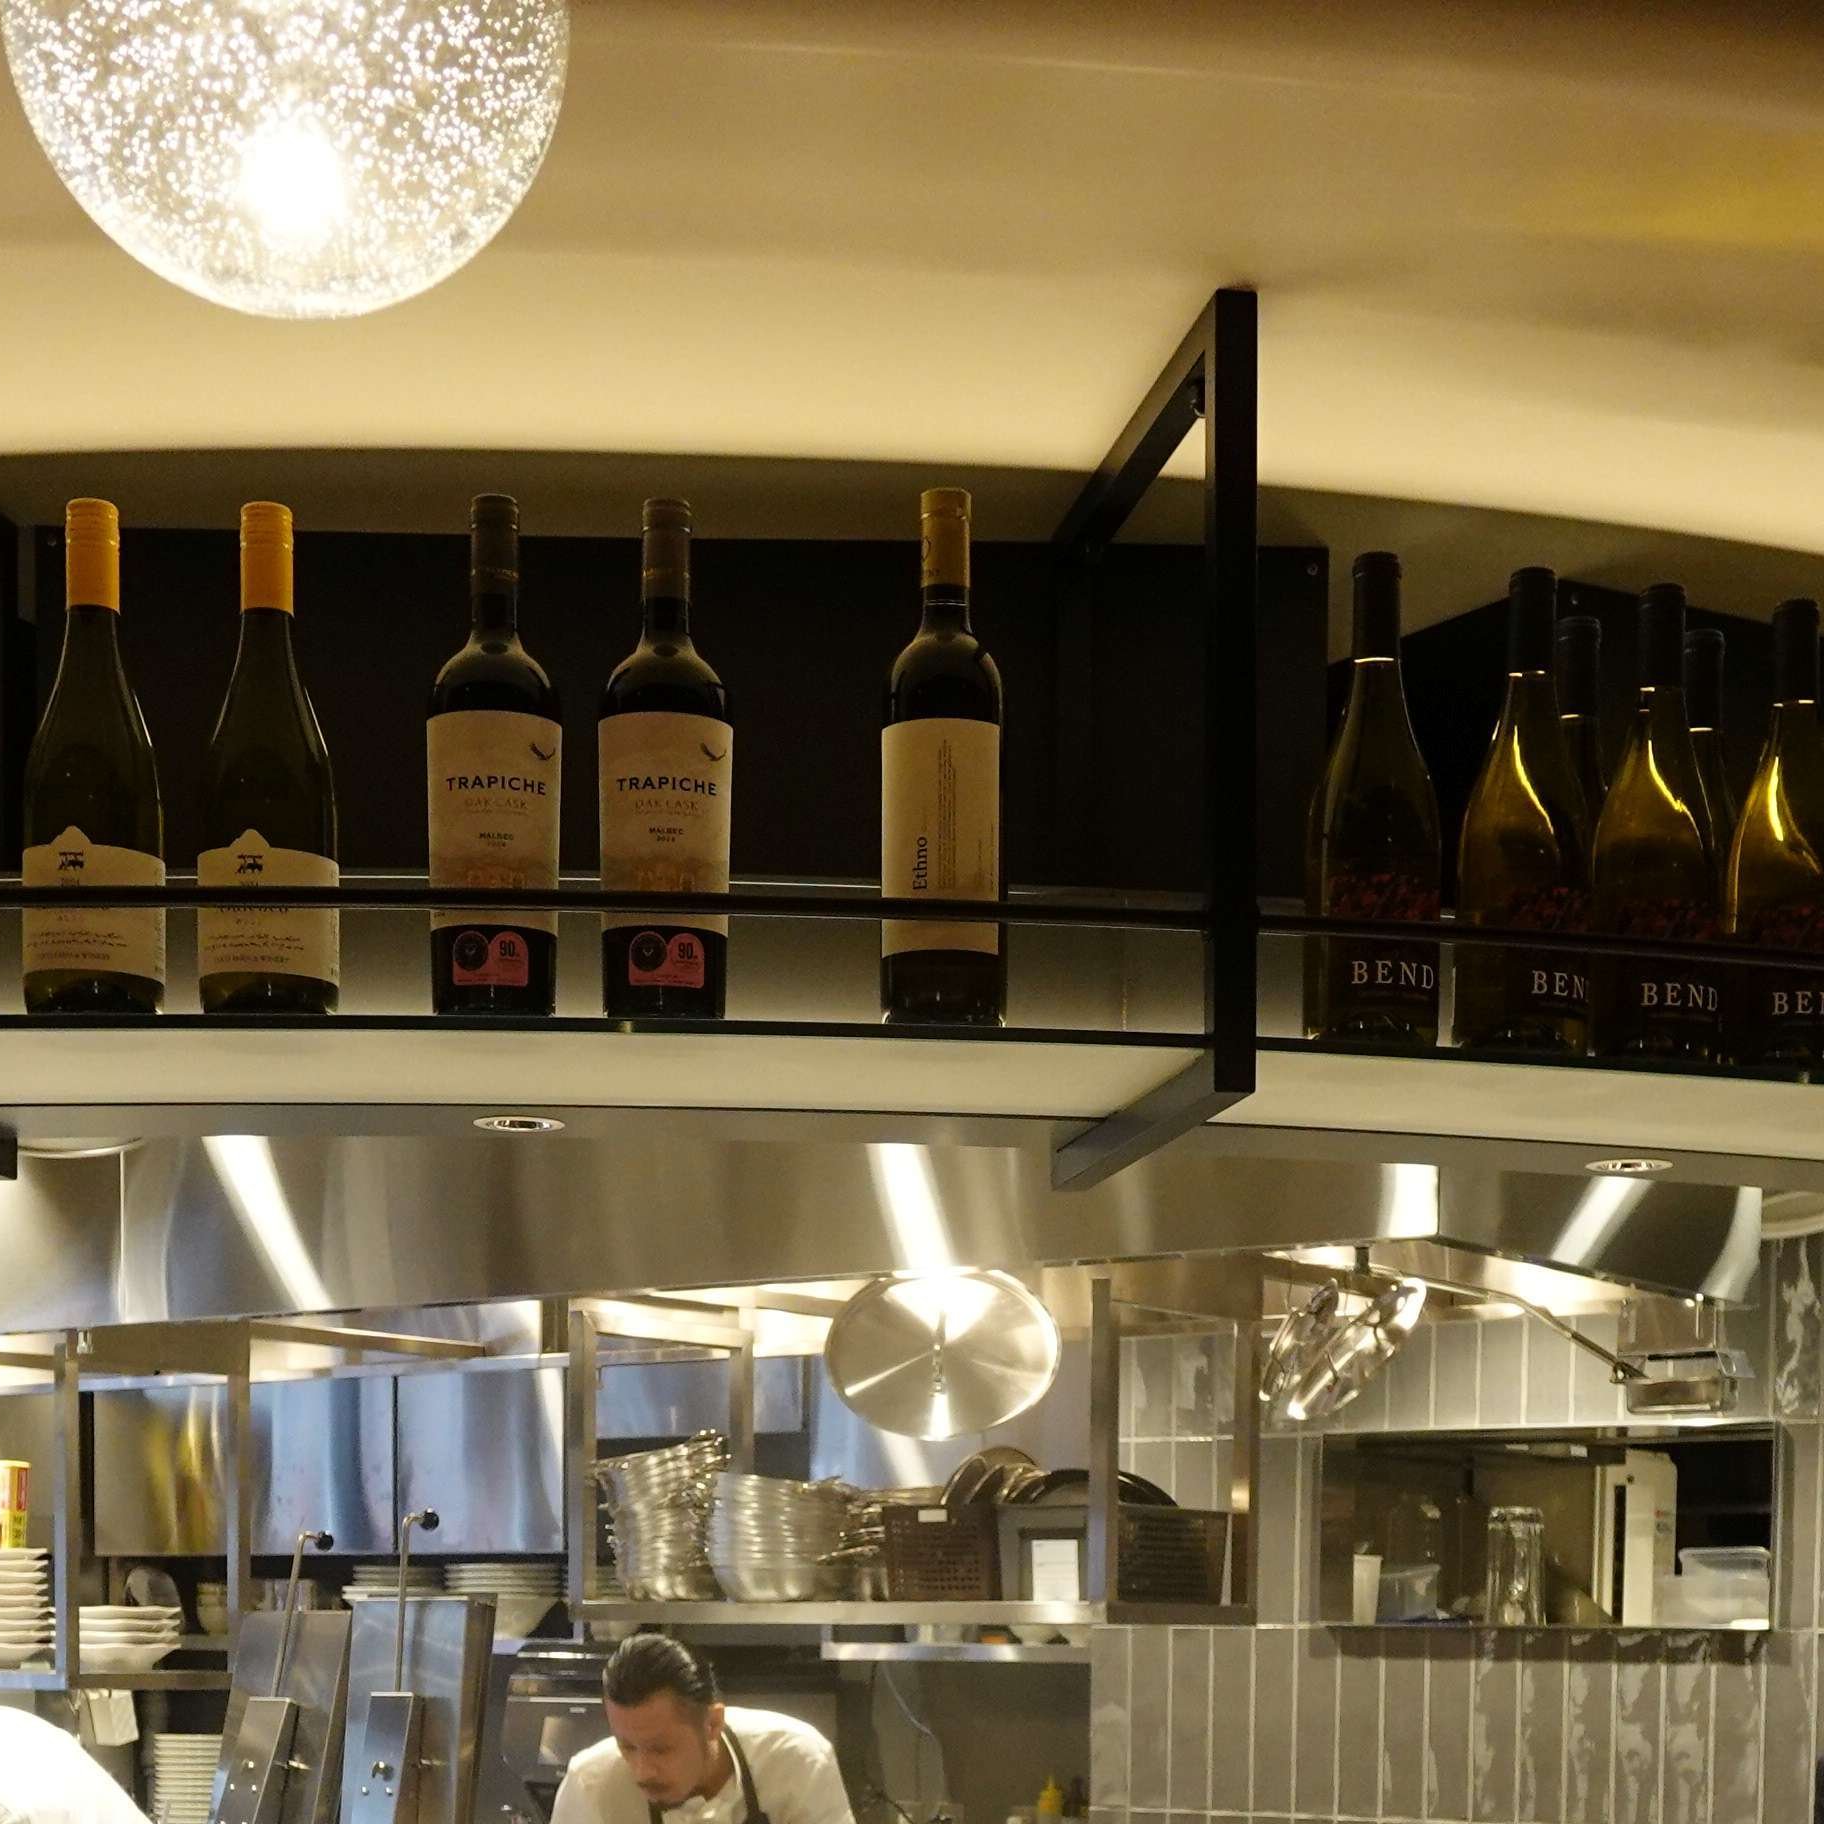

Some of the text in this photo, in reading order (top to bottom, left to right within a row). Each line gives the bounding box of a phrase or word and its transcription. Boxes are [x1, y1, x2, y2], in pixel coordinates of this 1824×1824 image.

[446, 776, 546, 796] TRAPICHE
[616, 776, 717, 796] TRAPICHE
[479, 832, 513, 841] MALBEC
[649, 827, 684, 835] MALBEC
[912, 836, 928, 890] Ethno
[500, 940, 516, 957] 90
[678, 942, 694, 960] 90
[1351, 960, 1434, 990] BEND
[1531, 970, 1588, 1000] BEN
[1639, 982, 1719, 1012] BEND
